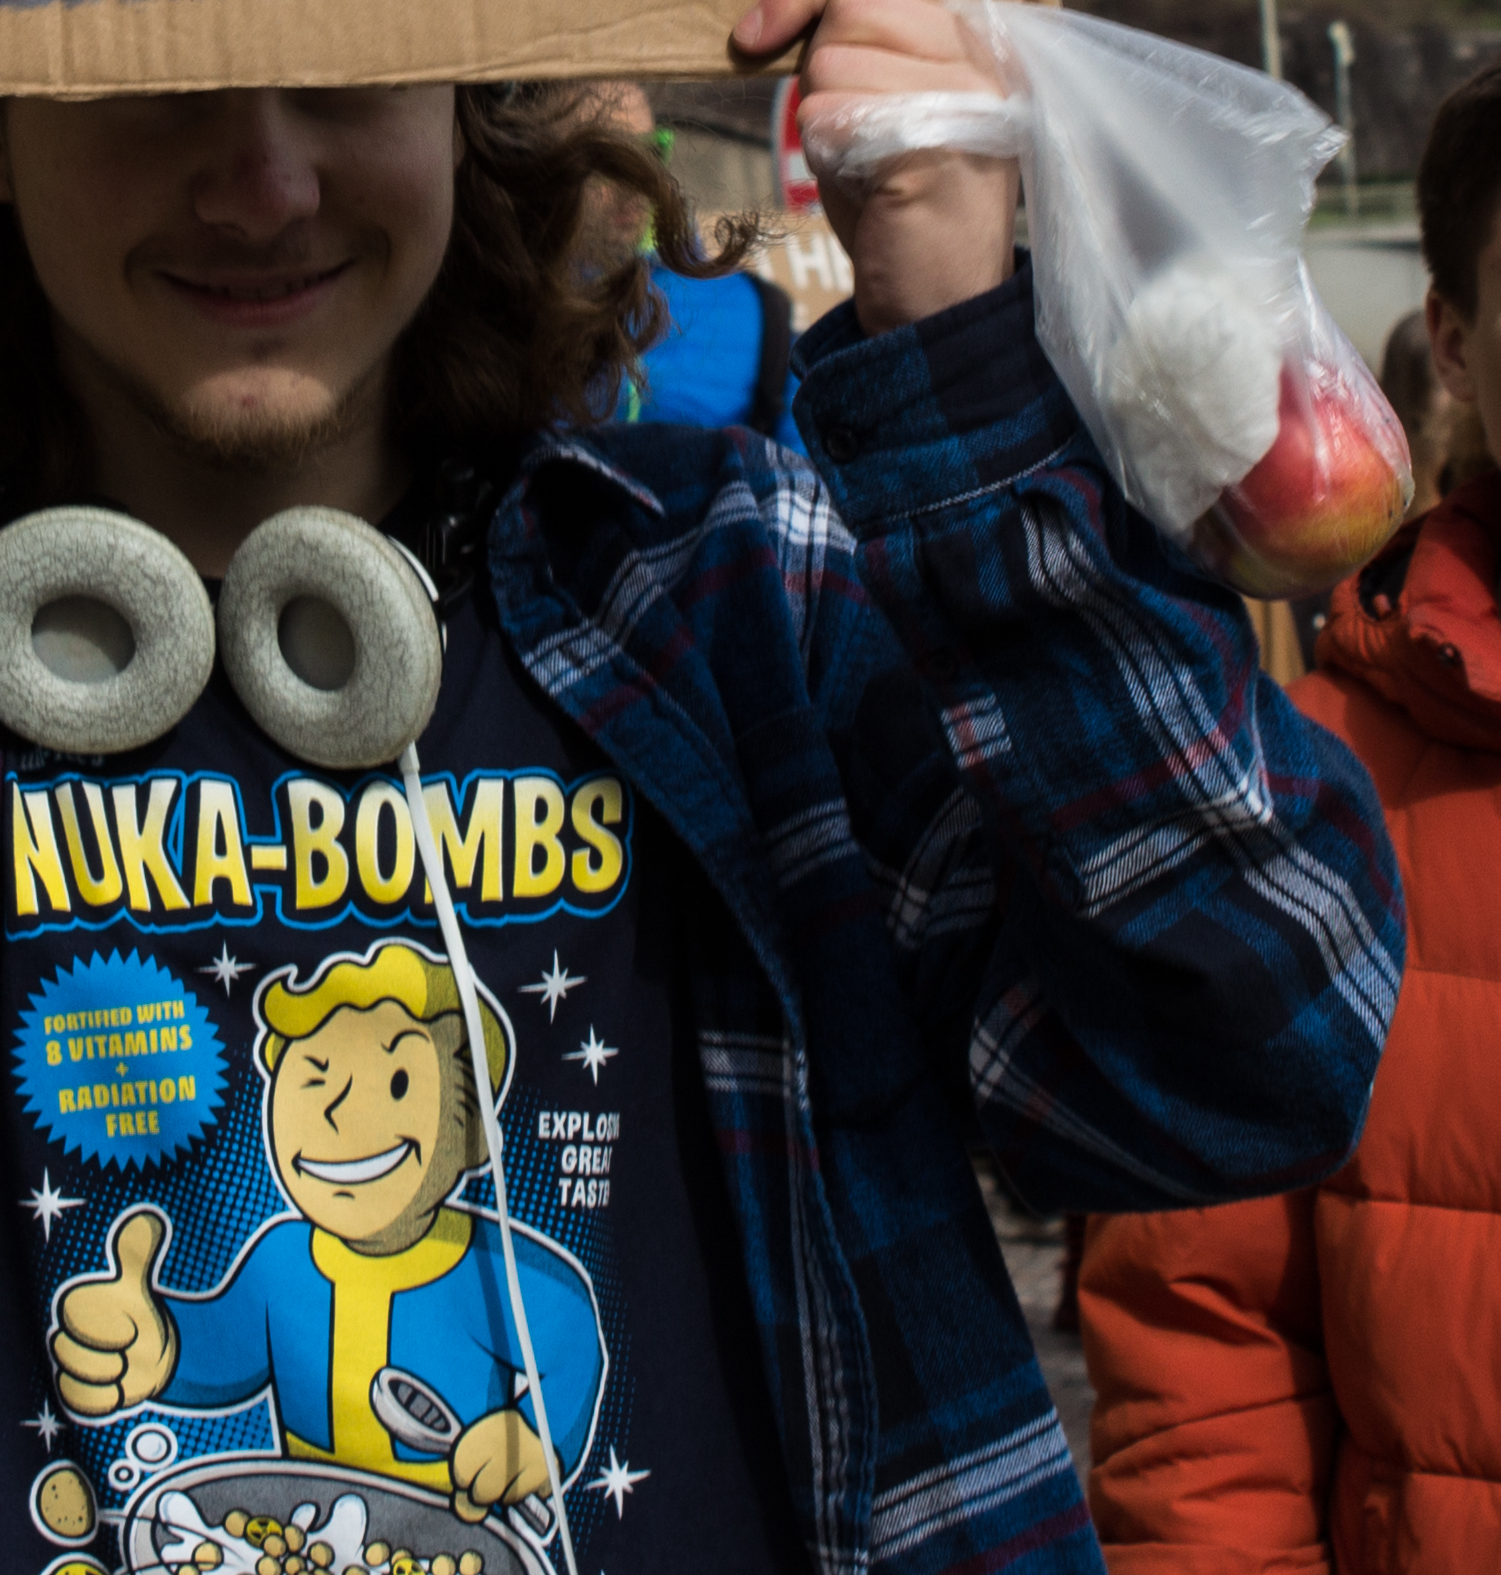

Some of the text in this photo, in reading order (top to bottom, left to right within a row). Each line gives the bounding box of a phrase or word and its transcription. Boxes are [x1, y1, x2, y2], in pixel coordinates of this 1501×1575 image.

[12, 778, 624, 916] NUKA-BOMBS
[44, 1000, 185, 1035] FORTIFIED WITH
[45, 1024, 193, 1066] 8 VITAMINS
[58, 1075, 196, 1114] RADIATION
[105, 1110, 160, 1138] FREE
